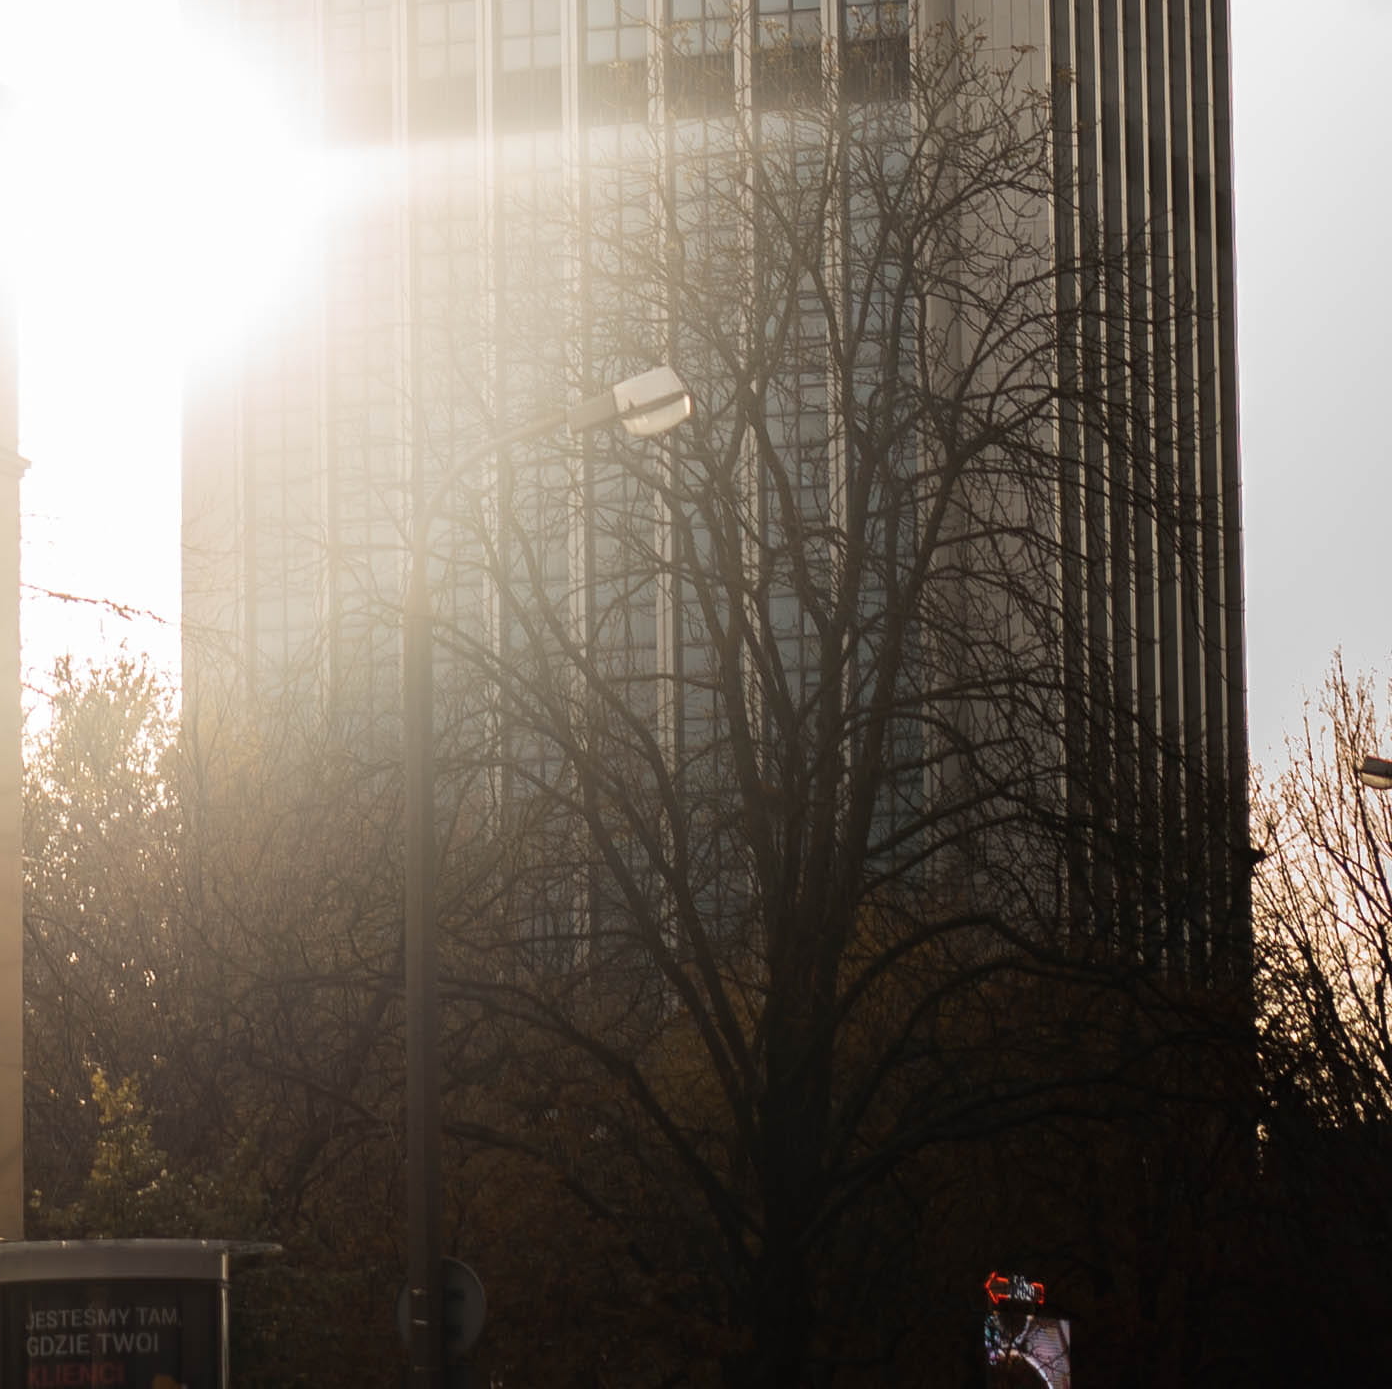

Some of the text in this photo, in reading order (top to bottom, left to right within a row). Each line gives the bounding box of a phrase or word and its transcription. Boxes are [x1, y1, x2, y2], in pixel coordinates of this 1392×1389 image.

[25, 1305, 128, 1329] JESTEŚMY
[26, 1333, 158, 1357] GDZIE TWOI
[28, 1363, 125, 1386] KLIENCI
